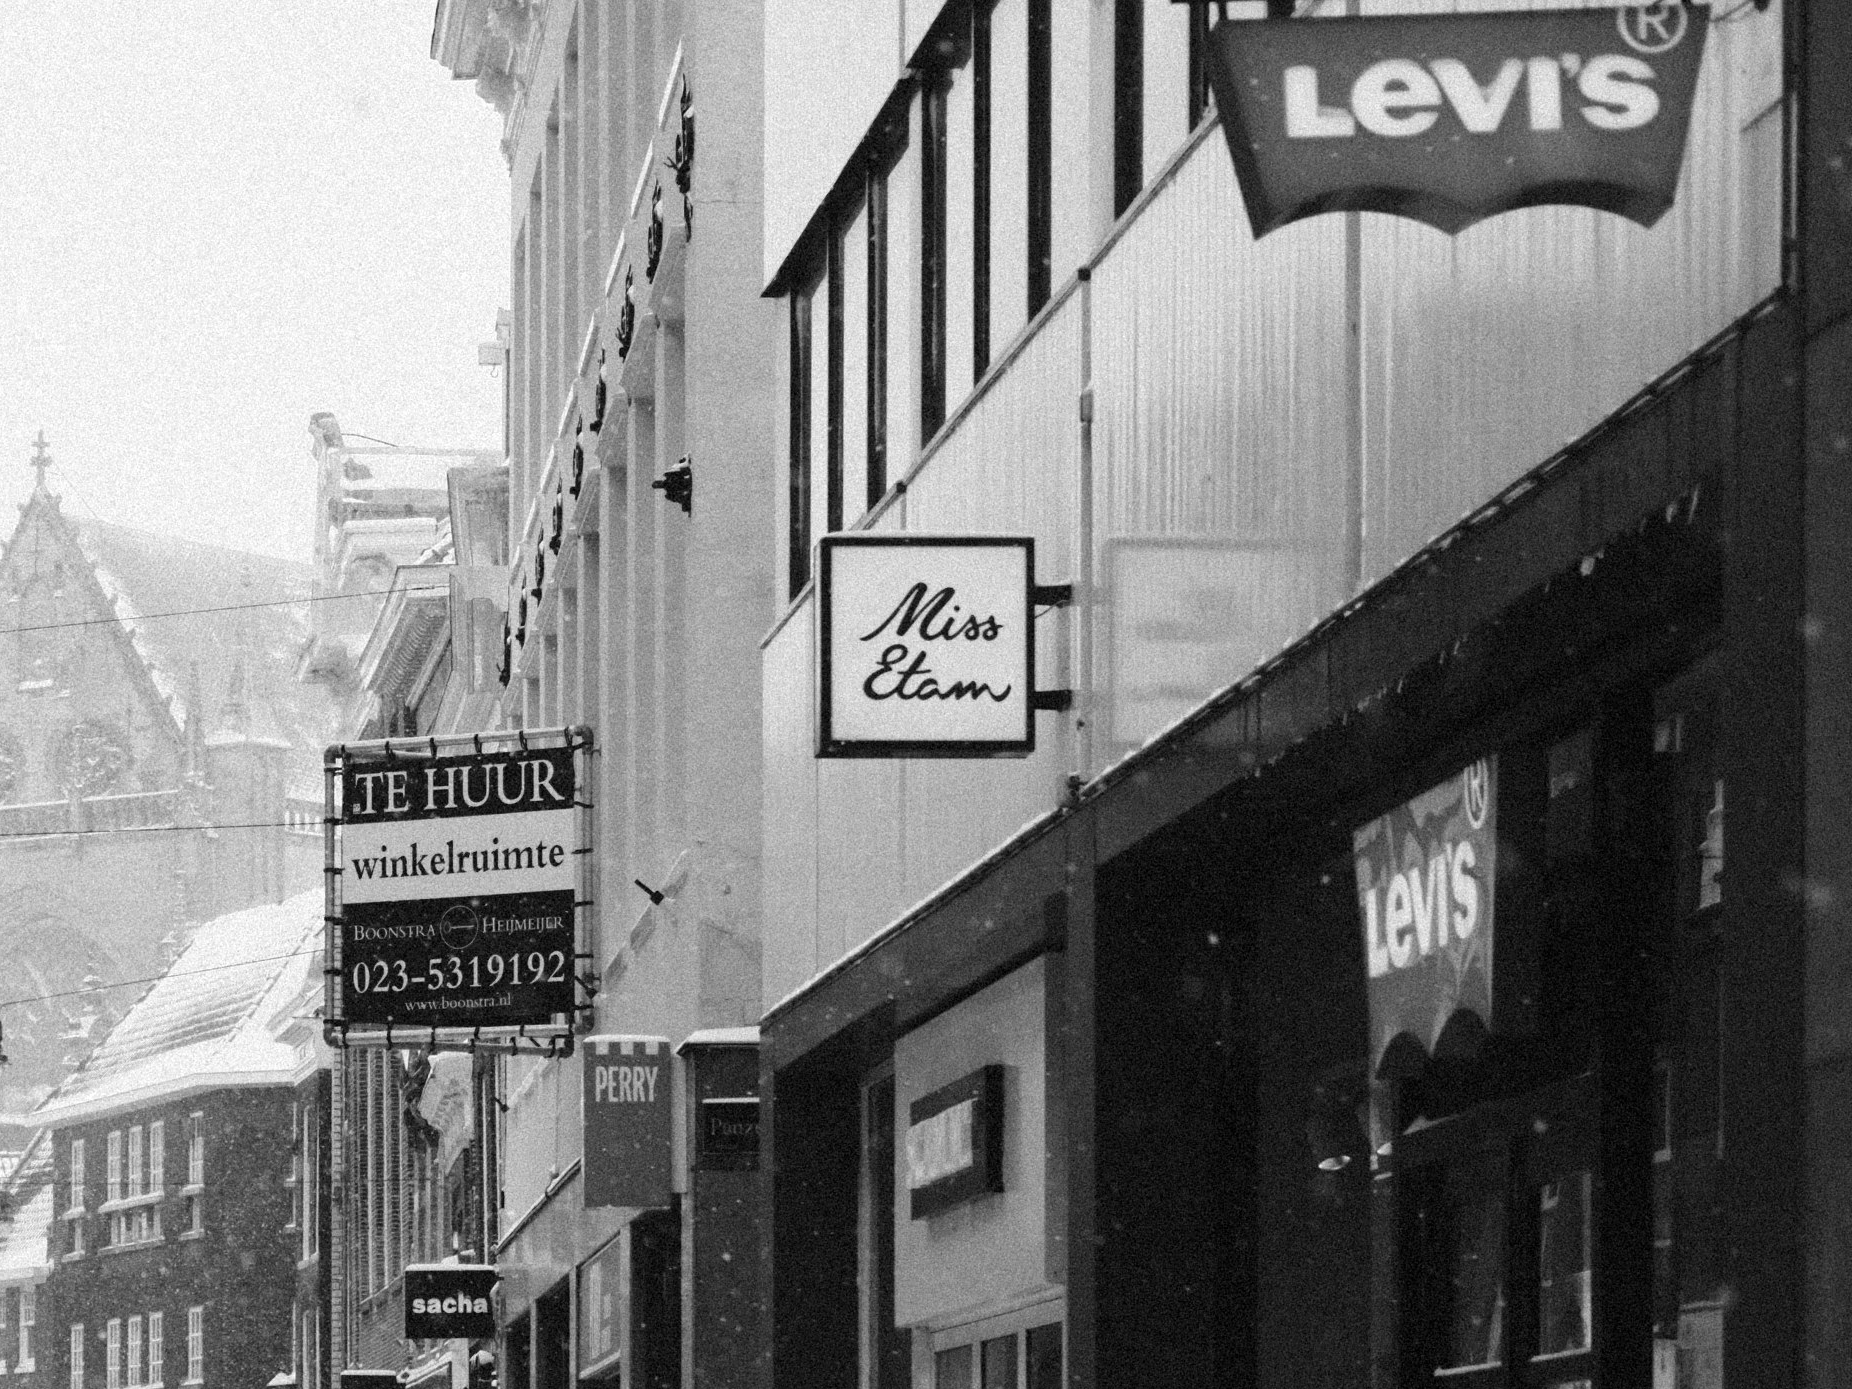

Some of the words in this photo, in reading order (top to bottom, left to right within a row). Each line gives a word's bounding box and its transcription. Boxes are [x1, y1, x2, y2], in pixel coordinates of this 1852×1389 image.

[859, 582, 1004, 642] Miss
[863, 644, 1012, 702] Etam
[355, 771, 410, 814] TE
[424, 759, 566, 810] HUUR
[352, 837, 565, 880] winkelruimte
[353, 950, 565, 994] 023-5319192
[405, 993, 511, 1011] www.boonstra.nl
[595, 1066, 659, 1102] PERRY
[412, 1291, 489, 1314] sacha
